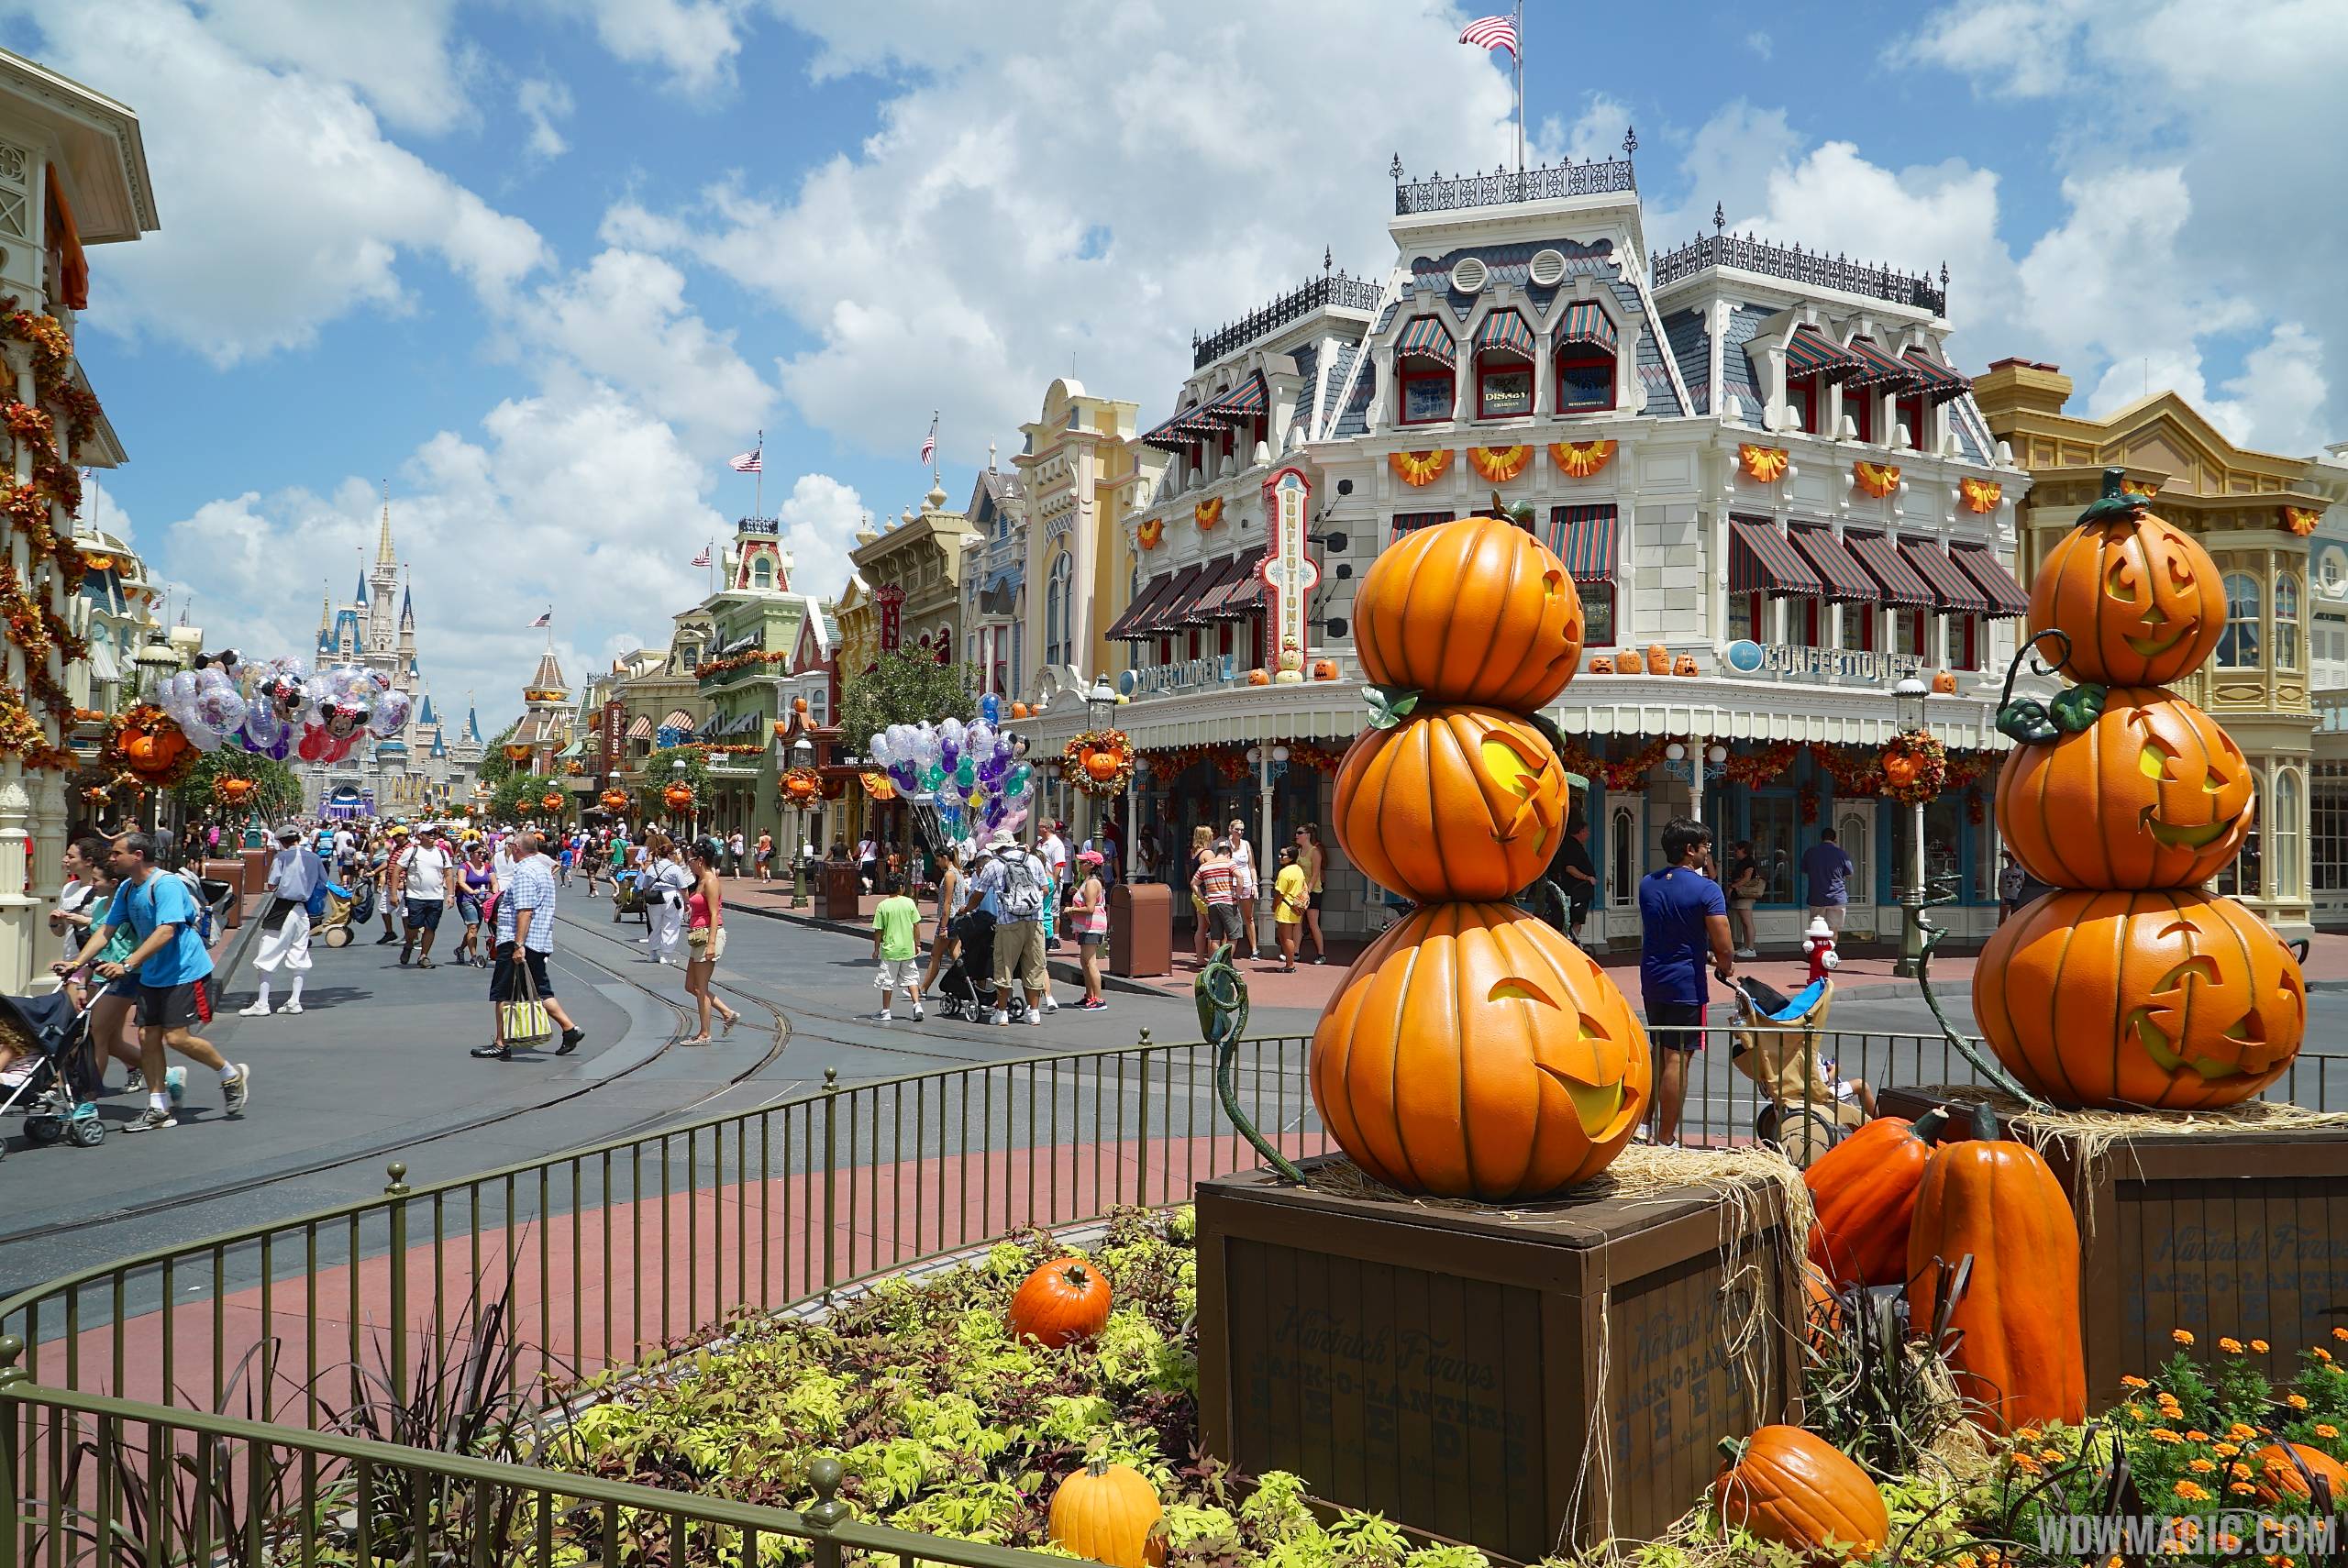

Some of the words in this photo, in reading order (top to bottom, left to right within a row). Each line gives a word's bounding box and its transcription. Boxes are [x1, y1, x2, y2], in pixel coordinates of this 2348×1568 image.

[1286, 490, 1296, 635] CONFECTIONE
[1763, 643, 1924, 681] CONFECTIONERY
[1251, 1350, 1526, 1440] JACK-O-LANTERN
